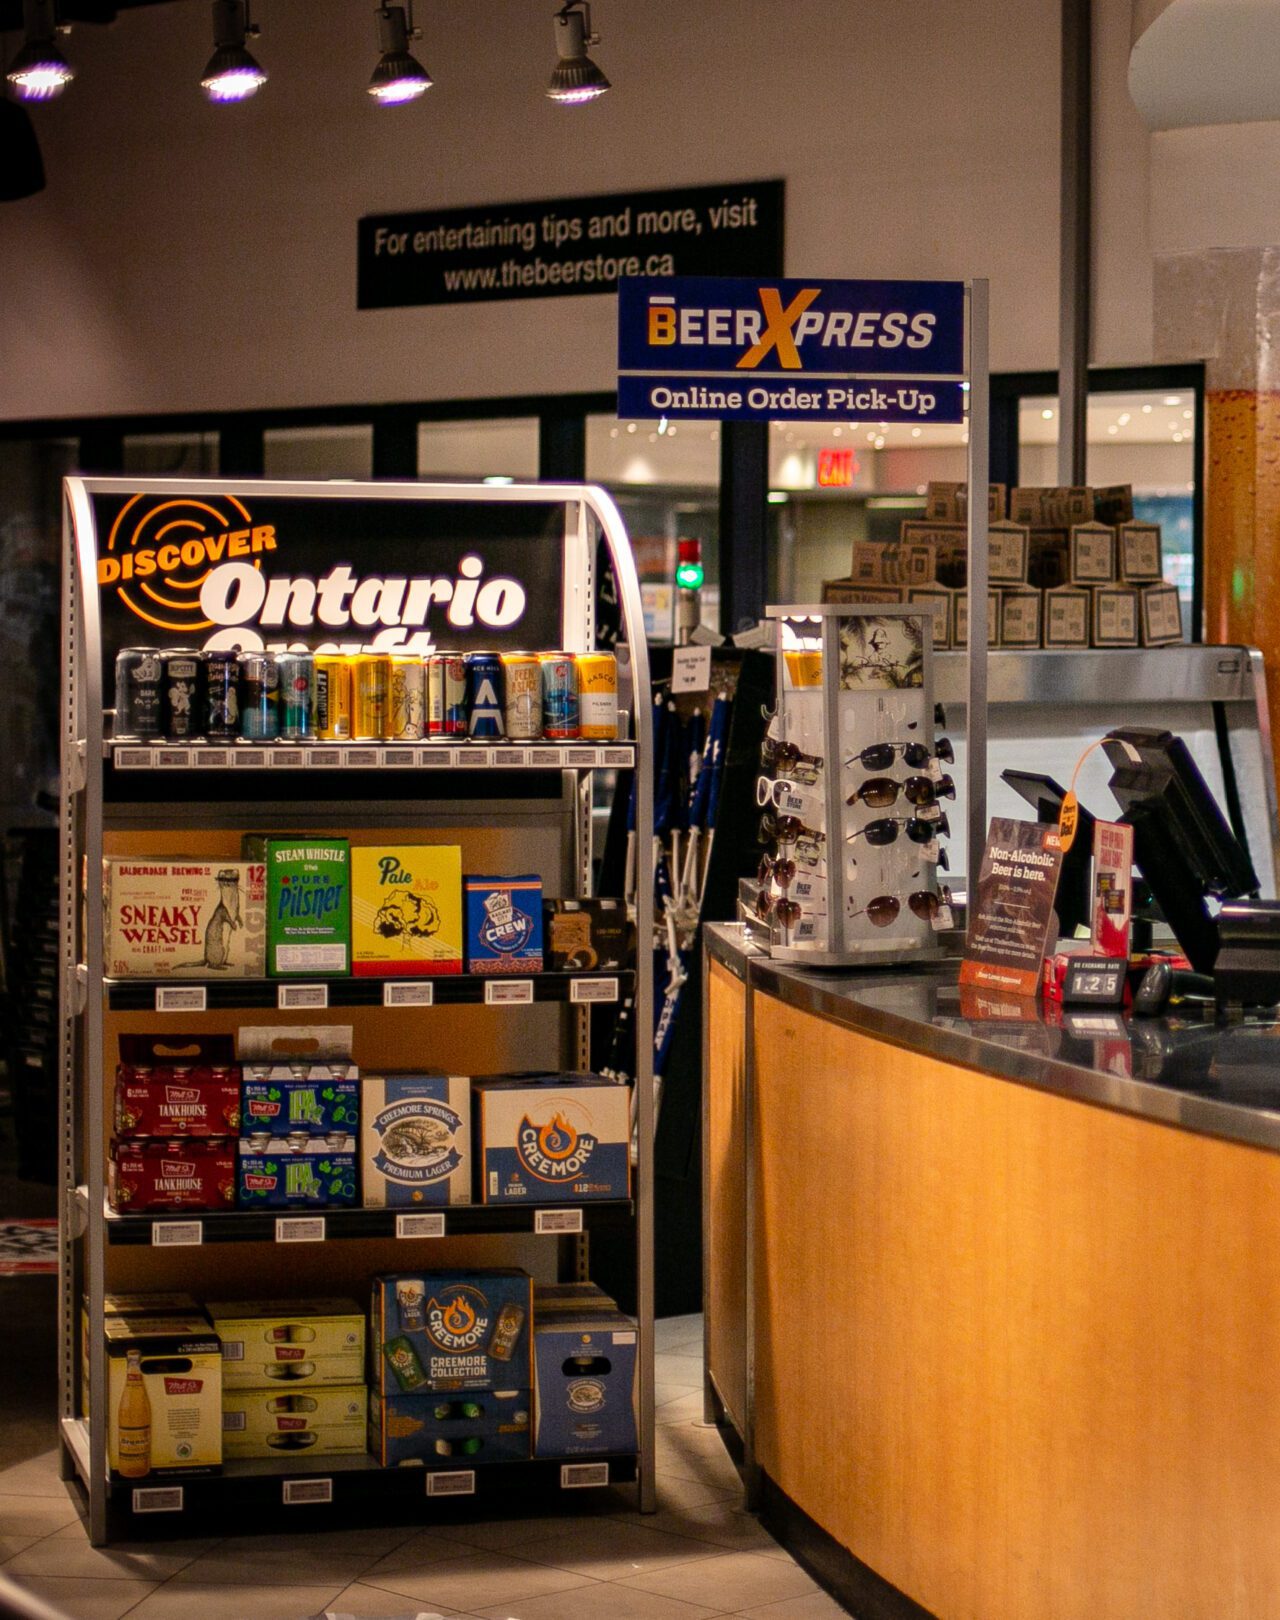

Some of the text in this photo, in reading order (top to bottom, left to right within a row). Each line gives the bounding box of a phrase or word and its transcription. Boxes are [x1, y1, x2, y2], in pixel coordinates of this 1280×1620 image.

[374, 197, 759, 256] For entertaining tips and more, visit
[444, 251, 675, 291] www.thebeerstore.ca
[650, 386, 936, 415] Online Order Pick-Up
[97, 525, 277, 585] DISCOVER
[199, 556, 526, 628] Ontario
[275, 847, 346, 864] STEAM WHISTLE
[989, 846, 1055, 867] Non-Alcoholic
[119, 866, 168, 876] BALDERDASH
[171, 866, 203, 876] BREWING
[247, 865, 265, 883] 12
[291, 875, 330, 885] PURE
[378, 856, 439, 891] Pale Ale
[991, 862, 1046, 881] Beer is here.
[277, 884, 344, 921] Pilsner
[120, 904, 202, 928] SNEAKY
[119, 927, 203, 945] WEASEL
[485, 918, 527, 942] CREW
[158, 1104, 208, 1117] TANKHOUSE
[379, 1104, 457, 1127] CREEMORE SPRINGS
[521, 1128, 595, 1177] CREEMORE
[382, 1159, 453, 1180] PREMIUM LAGER
[153, 1178, 203, 1191] TANKHOUSE
[504, 1186, 527, 1196] LAGER
[430, 1309, 489, 1348] CREEMORE
[430, 1355, 488, 1368] CREEMORE
[430, 1366, 487, 1378] COLLECTION
